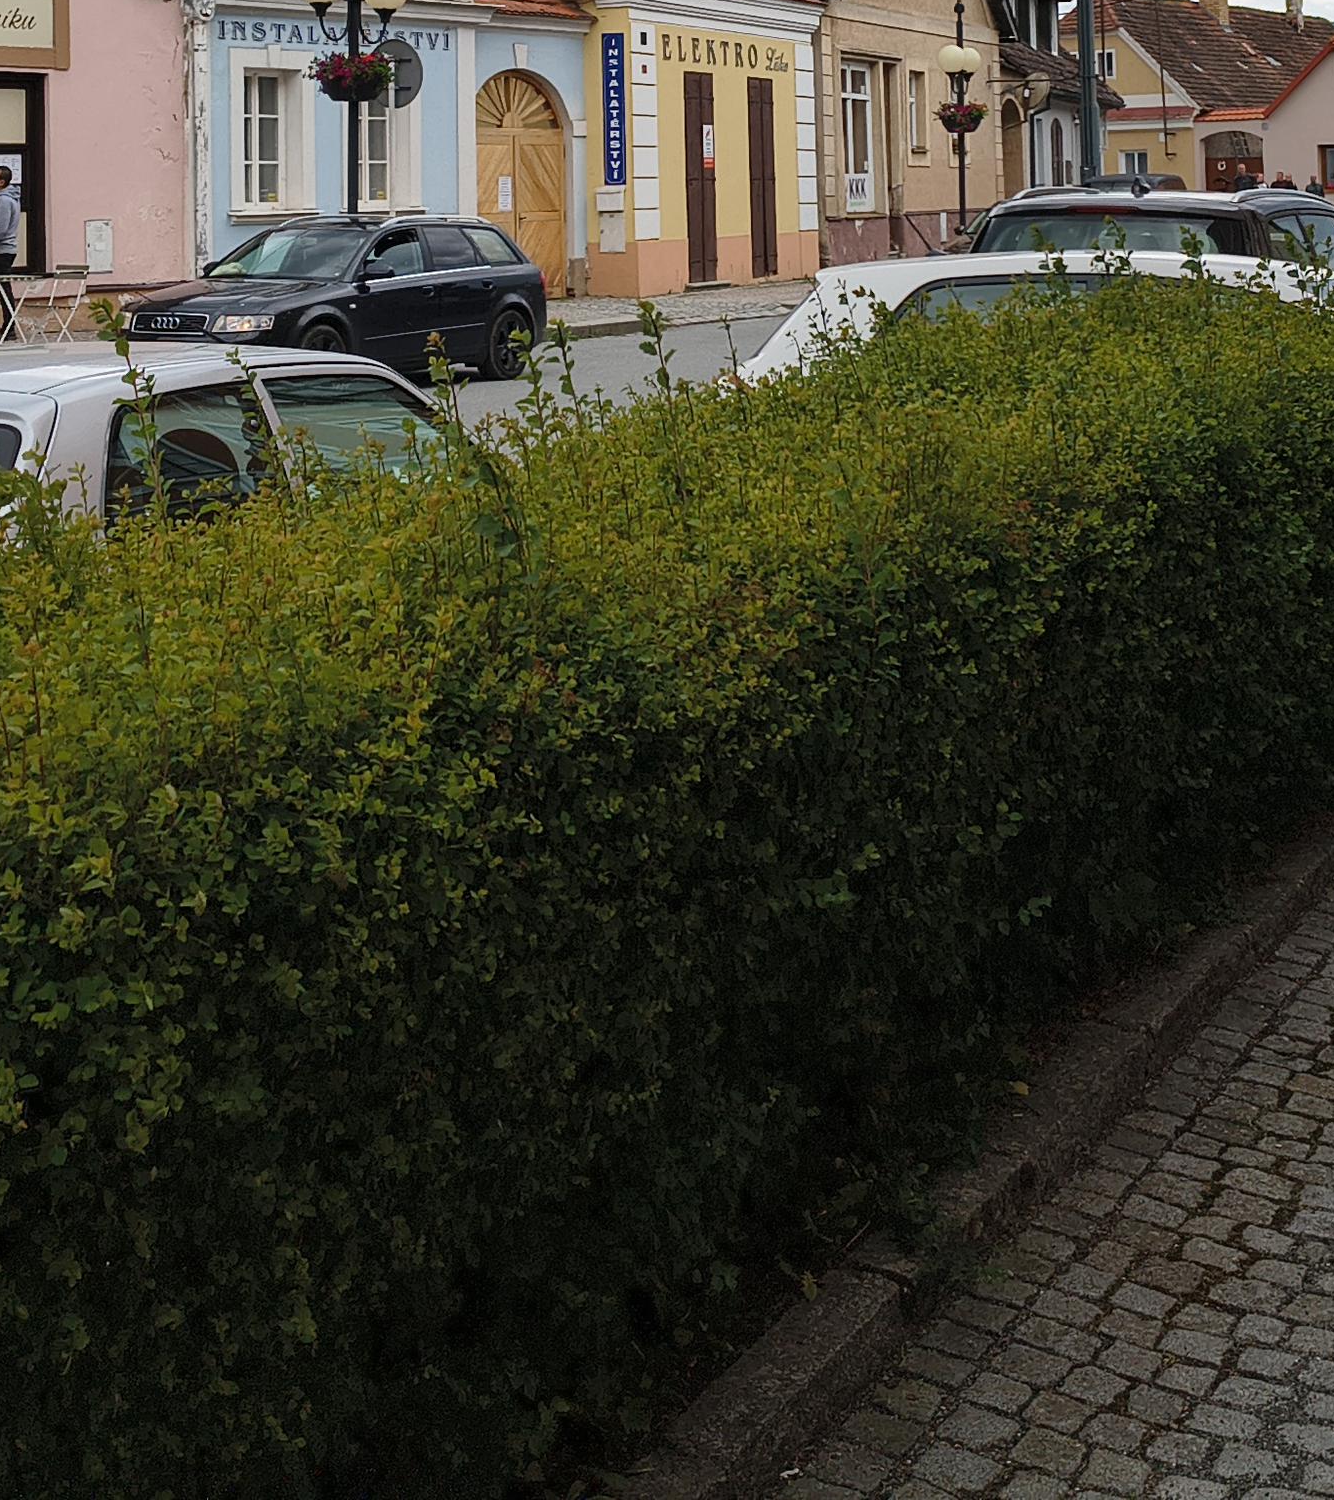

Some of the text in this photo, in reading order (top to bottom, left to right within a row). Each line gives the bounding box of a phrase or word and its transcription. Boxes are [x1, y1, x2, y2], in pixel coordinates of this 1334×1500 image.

[217, 19, 451, 51] INSTALAÉRSTVÍ
[661, 33, 759, 69] ELEKTRO
[609, 37, 621, 180] INSTALATÉRSTVÍ
